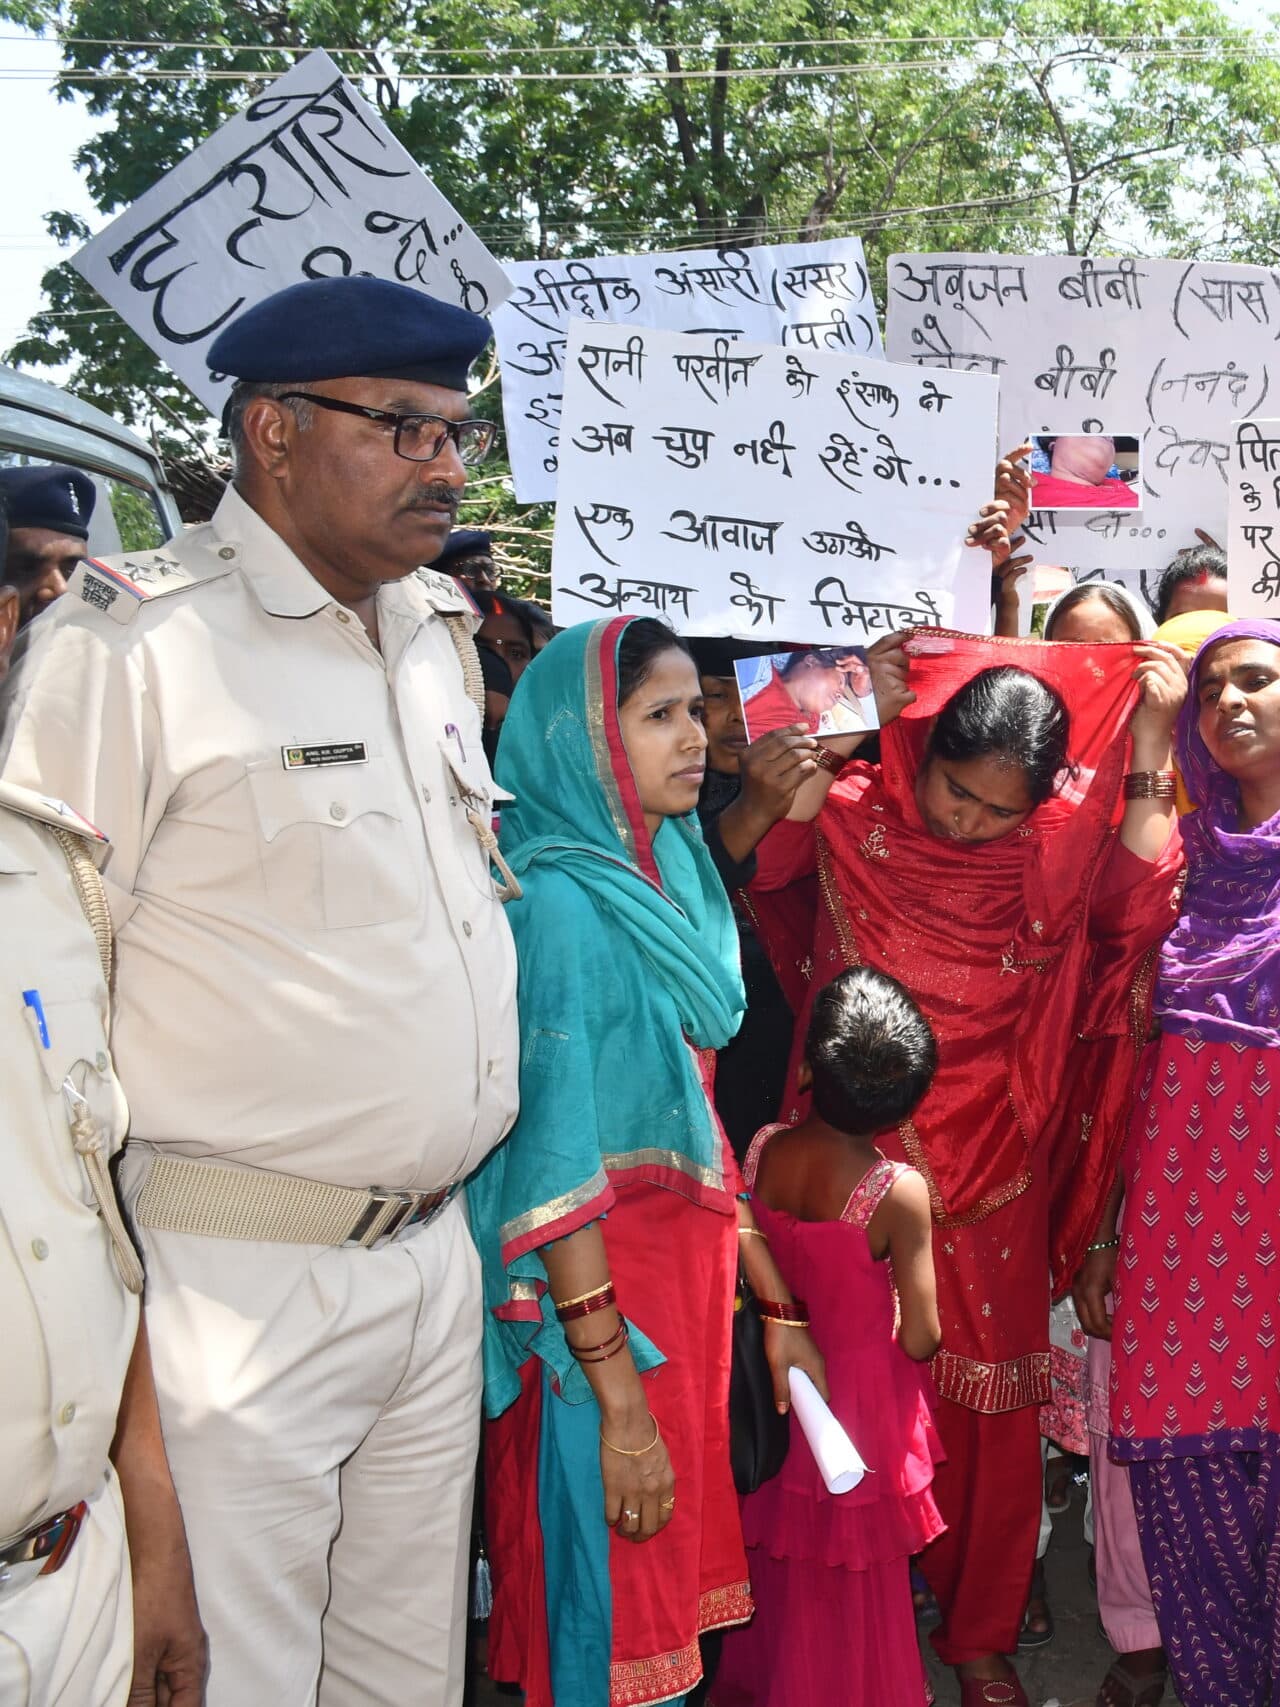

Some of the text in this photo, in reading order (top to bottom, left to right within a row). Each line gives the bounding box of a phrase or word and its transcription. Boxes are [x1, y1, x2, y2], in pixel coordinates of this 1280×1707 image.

[655, 249, 776, 307] अंसारी
[1059, 259, 1150, 310] बीबी
[578, 335, 648, 408] रानी
[672, 336, 763, 405] परवीन
[785, 354, 819, 398] को
[836, 370, 900, 431] इंसाफ
[918, 380, 953, 414] दो
[1034, 344, 1118, 399] बीबी
[571, 422, 635, 457] अब
[652, 426, 716, 469] चुप
[1239, 482, 1262, 512] के
[573, 502, 898, 568] एक आवाज उठाओ
[556, 572, 700, 620] अन्याय
[729, 571, 786, 626] को
